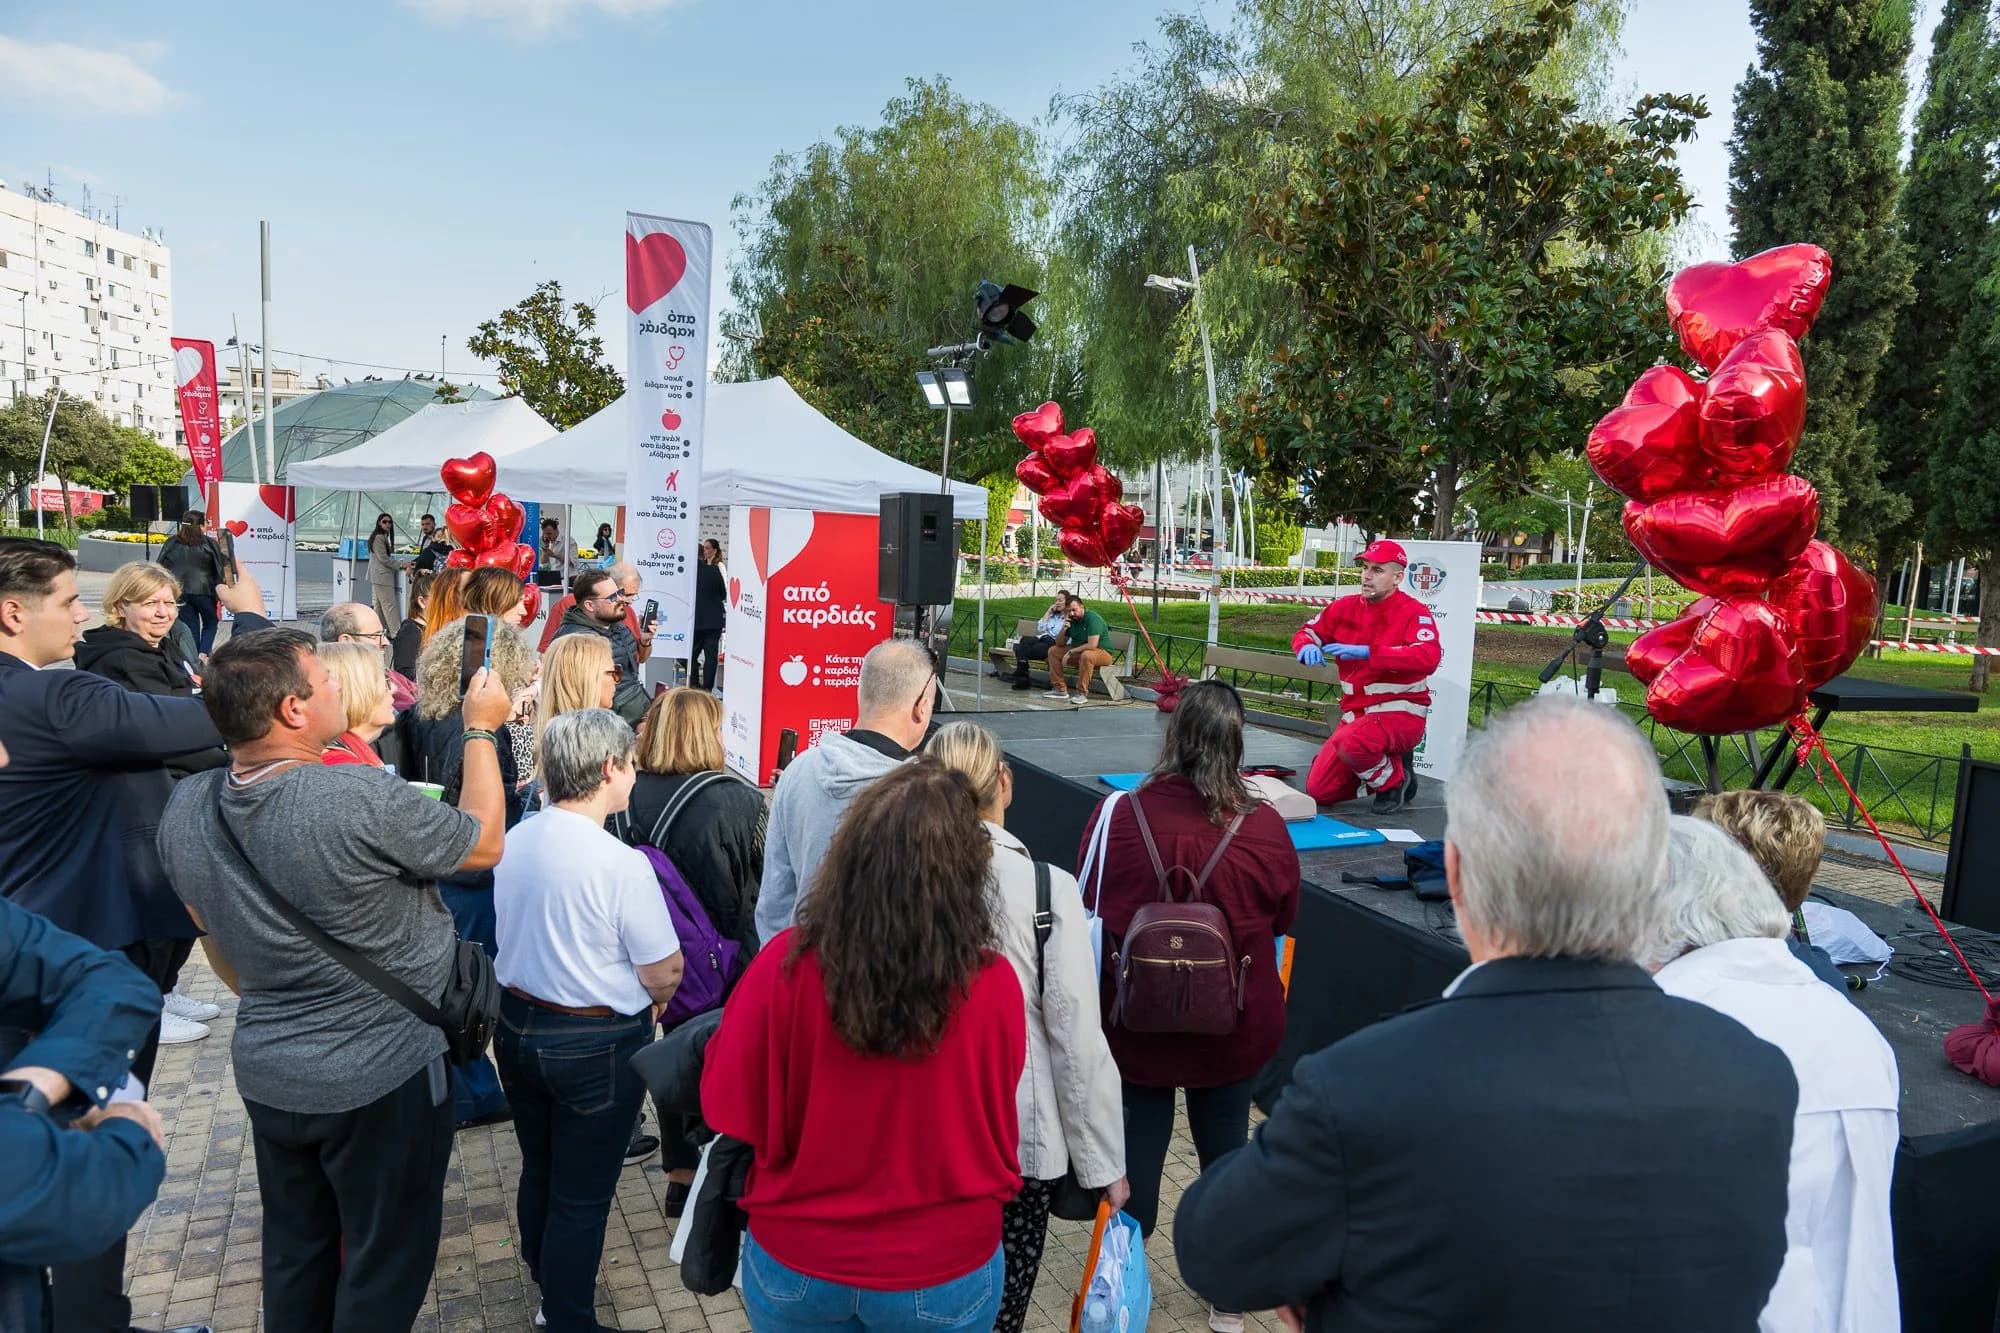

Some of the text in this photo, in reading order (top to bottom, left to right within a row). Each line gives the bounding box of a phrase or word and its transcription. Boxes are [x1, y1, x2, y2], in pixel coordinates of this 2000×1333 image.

[257, 525, 274, 533] από
[783, 581, 831, 602] από
[783, 604, 877, 630] καρδιάς
[825, 654, 850, 664] Κάνε
[825, 665, 859, 677] καρδιά
[824, 676, 861, 688] περιβόλ
